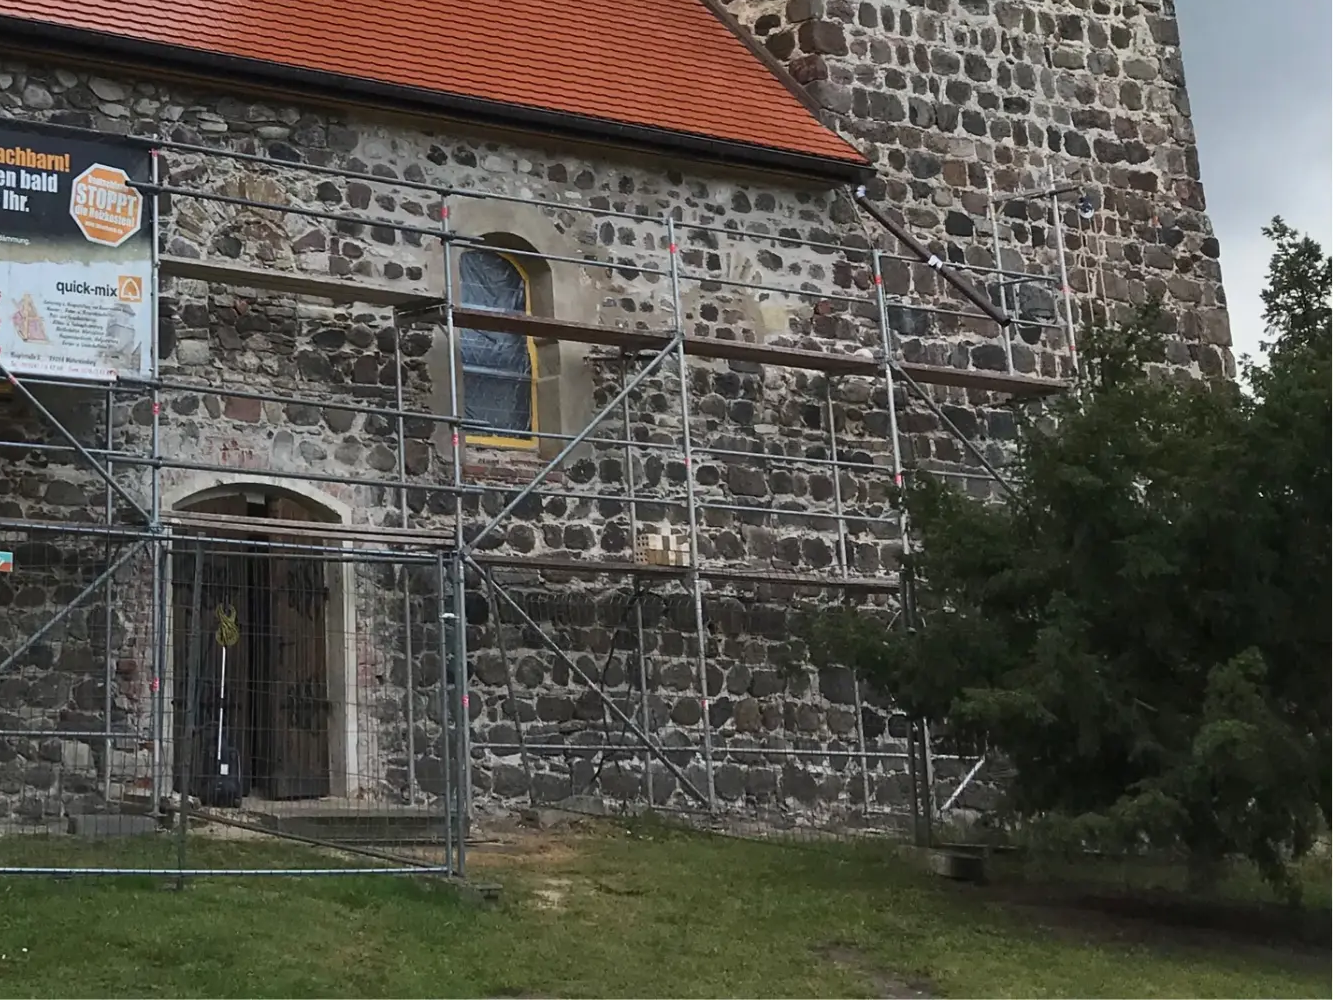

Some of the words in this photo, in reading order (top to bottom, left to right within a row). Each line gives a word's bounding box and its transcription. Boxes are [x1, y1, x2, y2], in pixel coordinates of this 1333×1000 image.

[20, 169, 58, 193] bald
[2, 189, 30, 213] Ihr.
[76, 182, 138, 217] STOPPT
[56, 280, 118, 297] quick-mix
